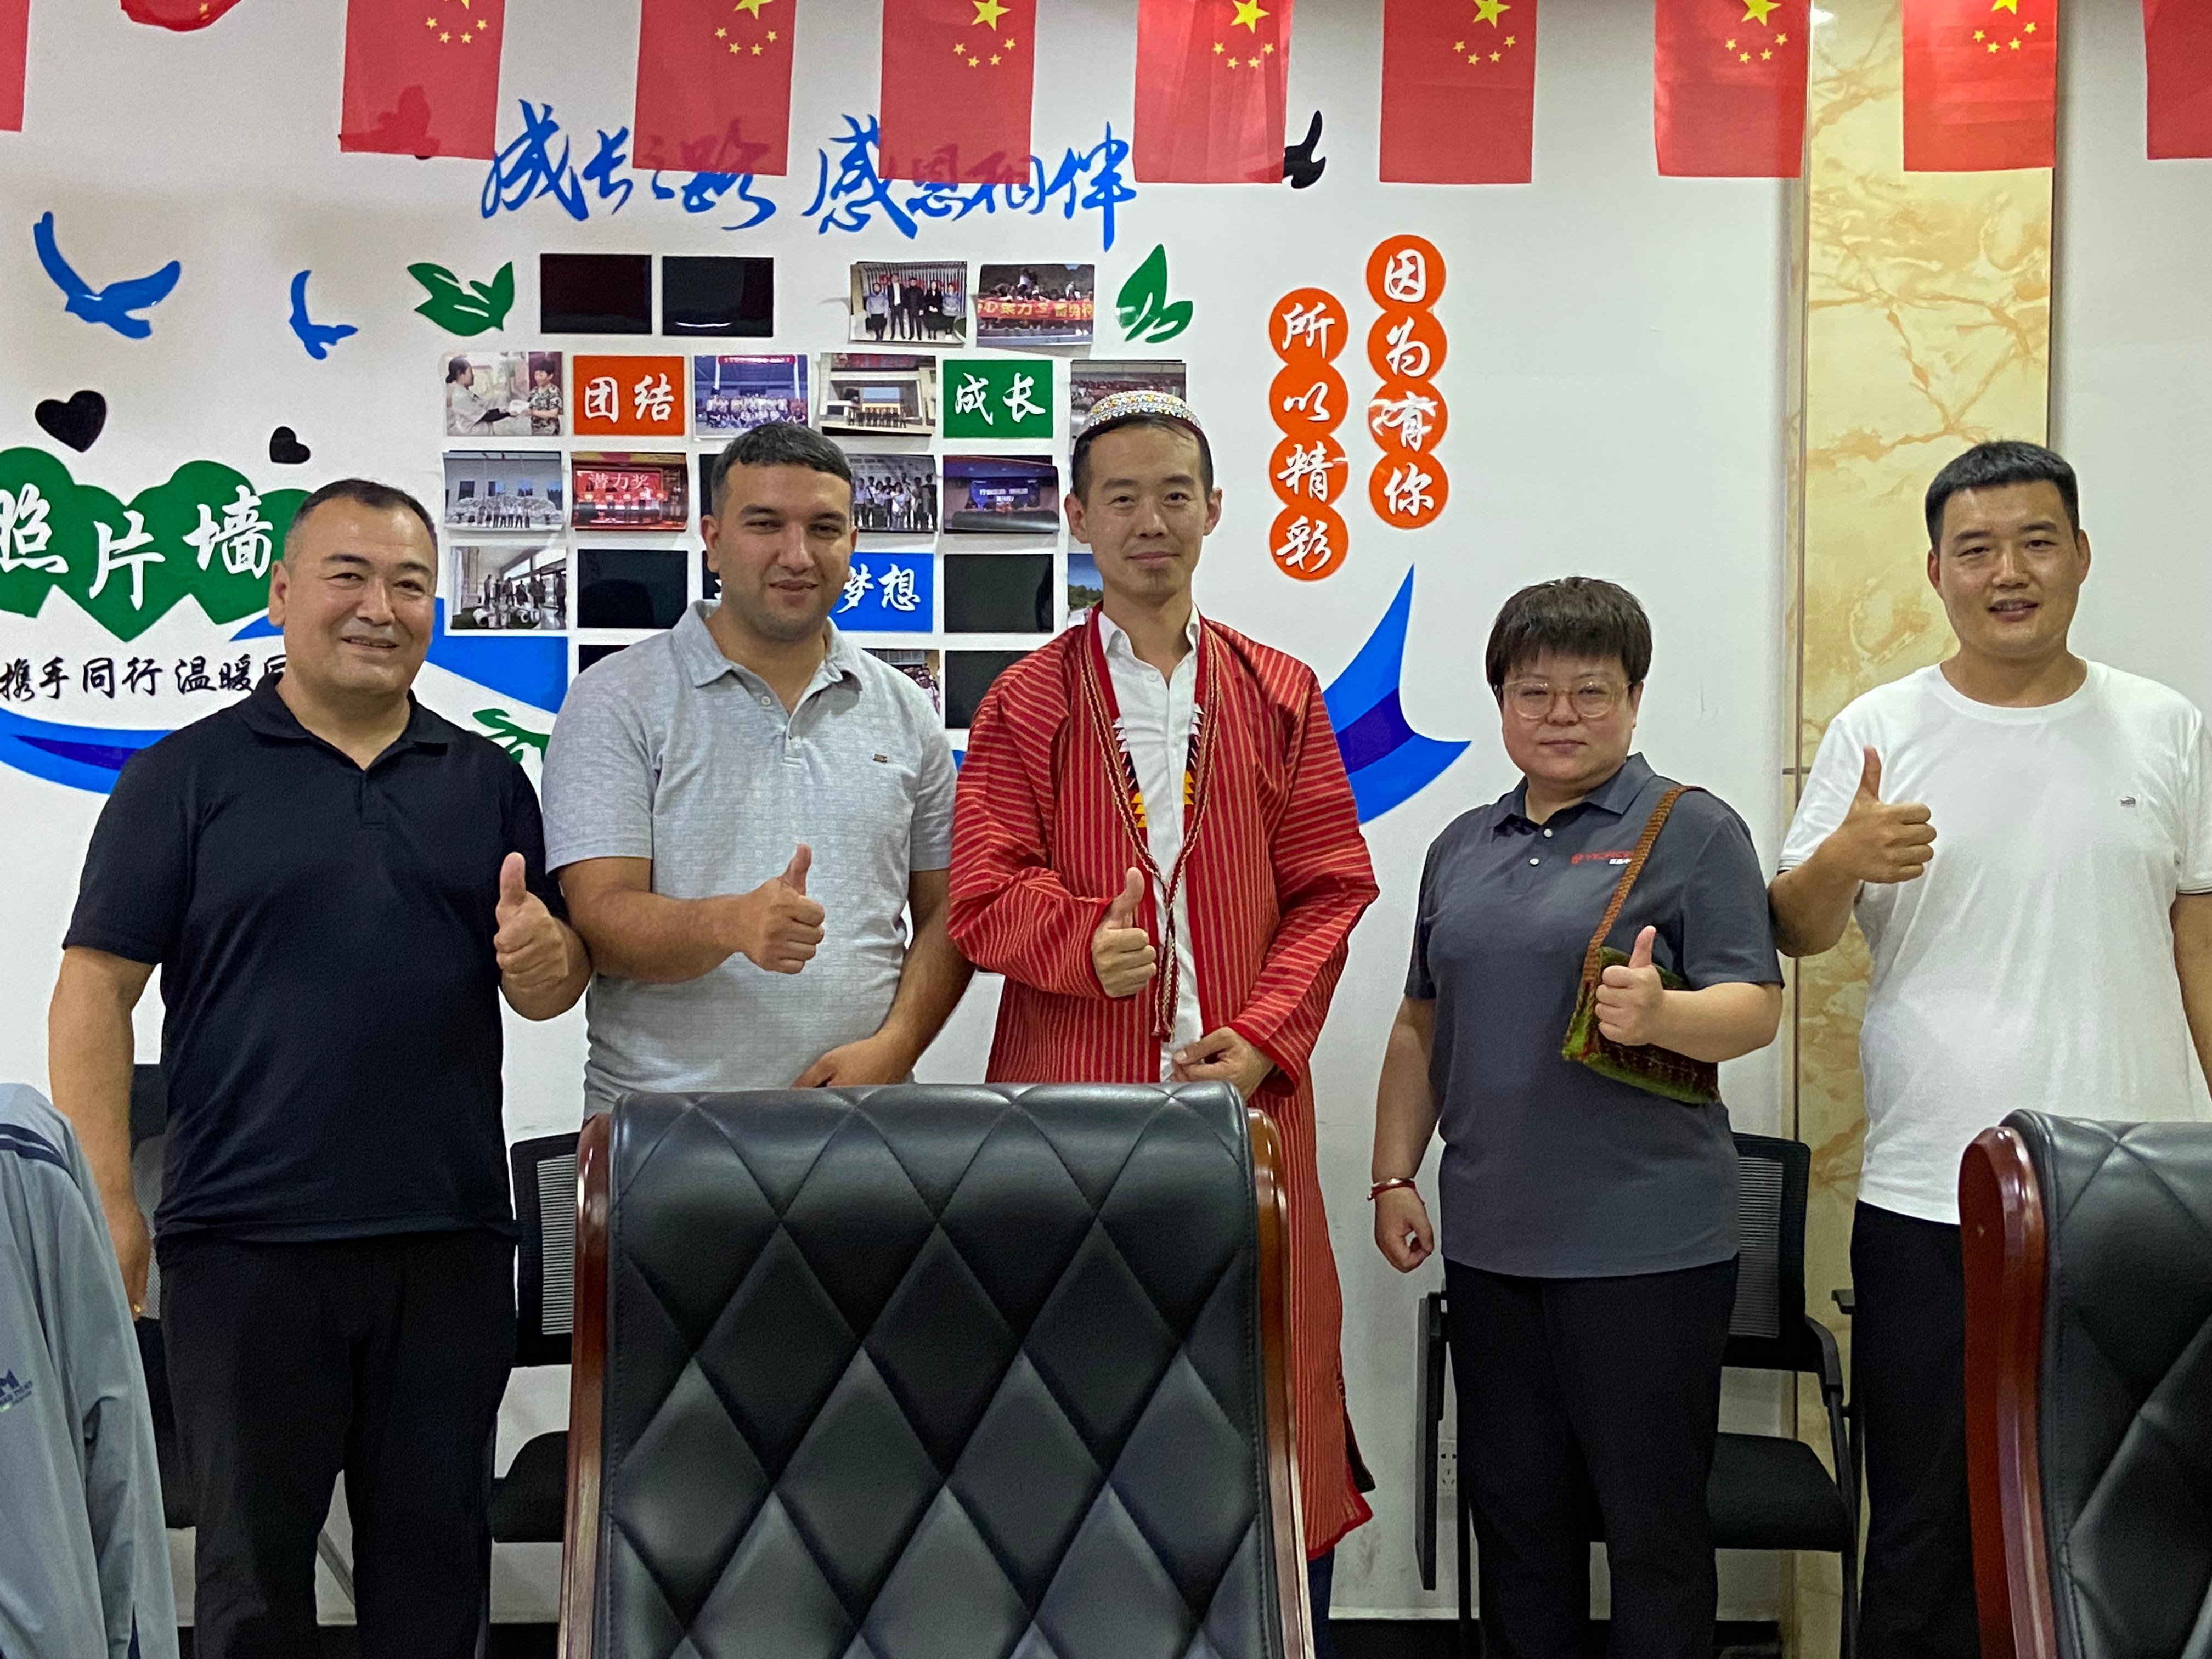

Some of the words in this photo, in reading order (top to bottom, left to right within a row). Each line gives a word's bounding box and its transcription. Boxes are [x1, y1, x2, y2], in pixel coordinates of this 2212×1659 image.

[584, 373, 675, 423] 团结
[955, 372, 1046, 424] 成长
[1384, 249, 1438, 517] 因为有你
[1276, 301, 1335, 573] 所以精彩
[0, 483, 273, 610] 照片墙
[837, 563, 921, 613] 梦想
